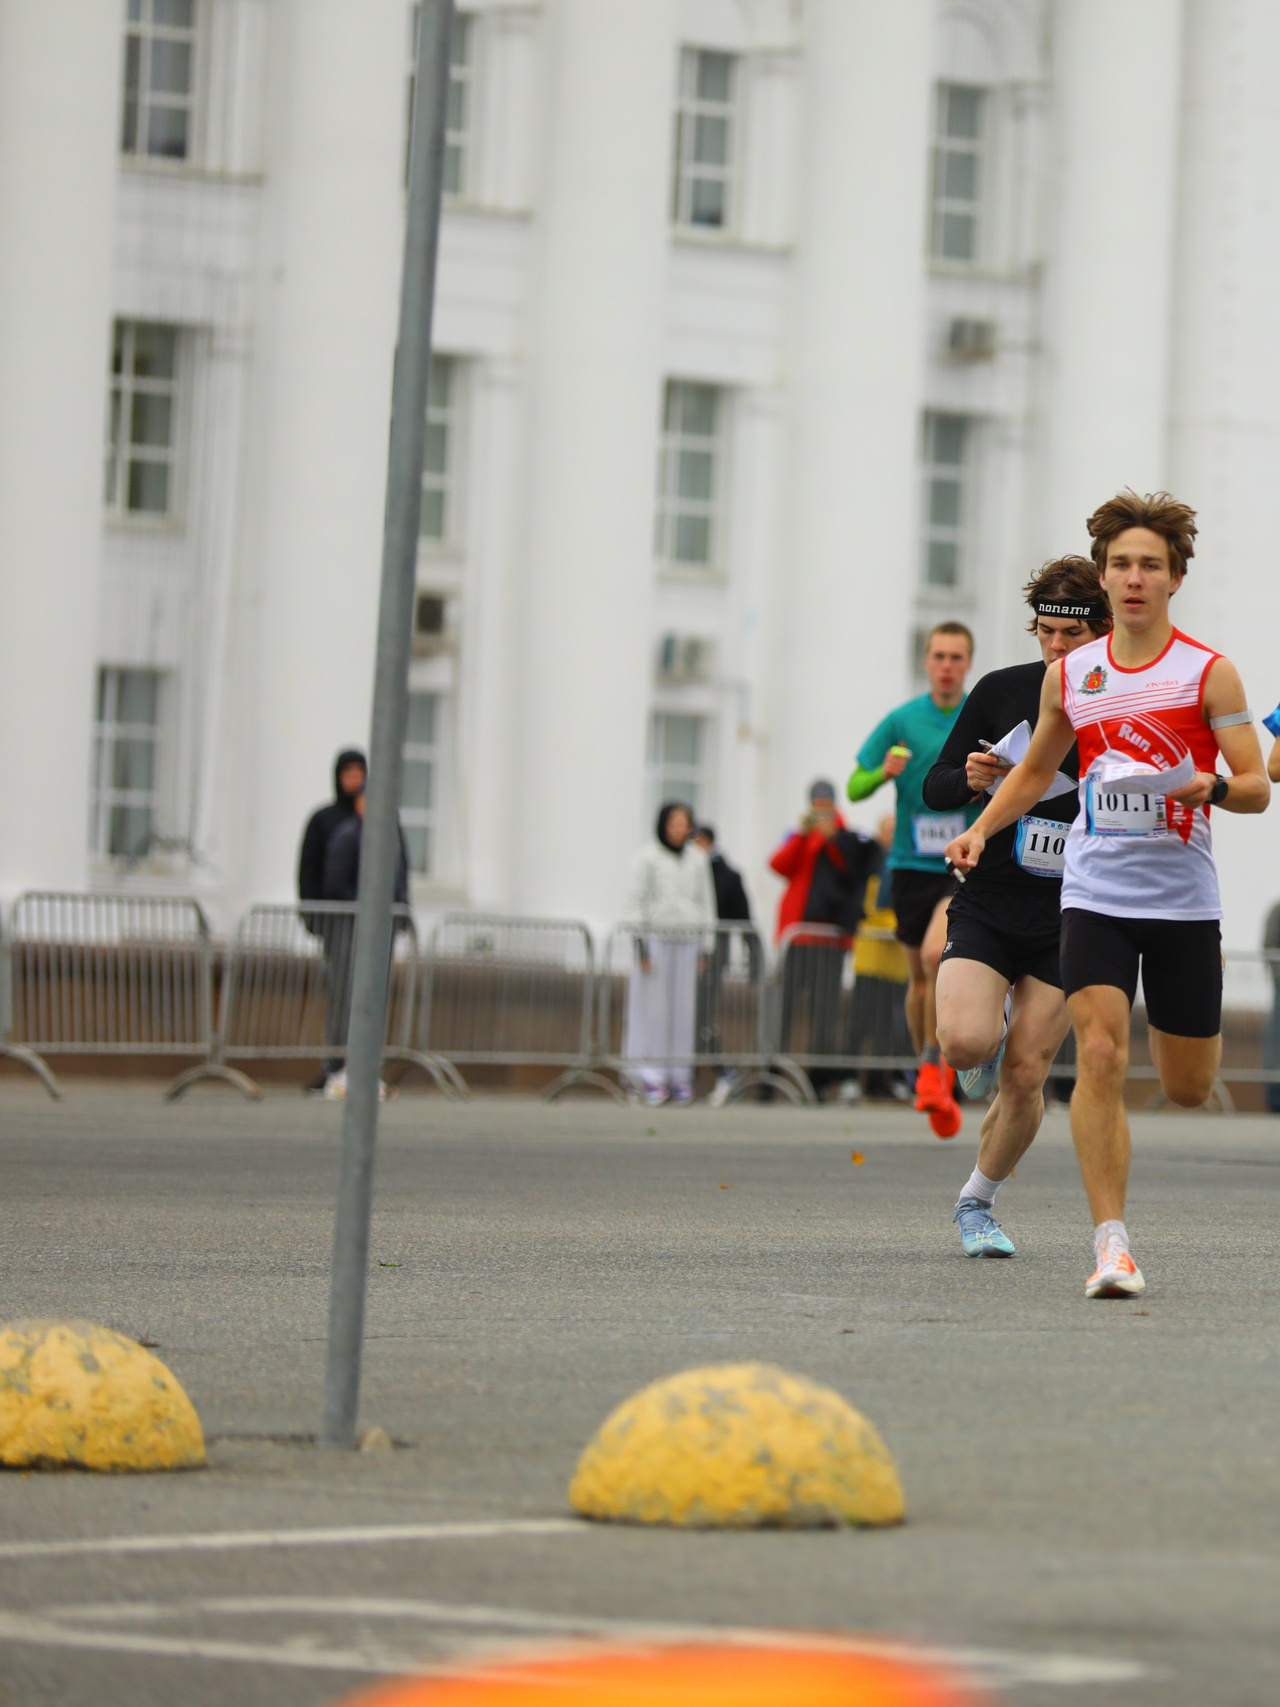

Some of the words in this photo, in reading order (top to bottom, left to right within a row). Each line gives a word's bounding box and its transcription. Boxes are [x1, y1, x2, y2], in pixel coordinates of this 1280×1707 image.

[1039, 603, 1090, 615] noname
[1118, 723, 1151, 752] Run
[1096, 793, 1151, 812] 101.1
